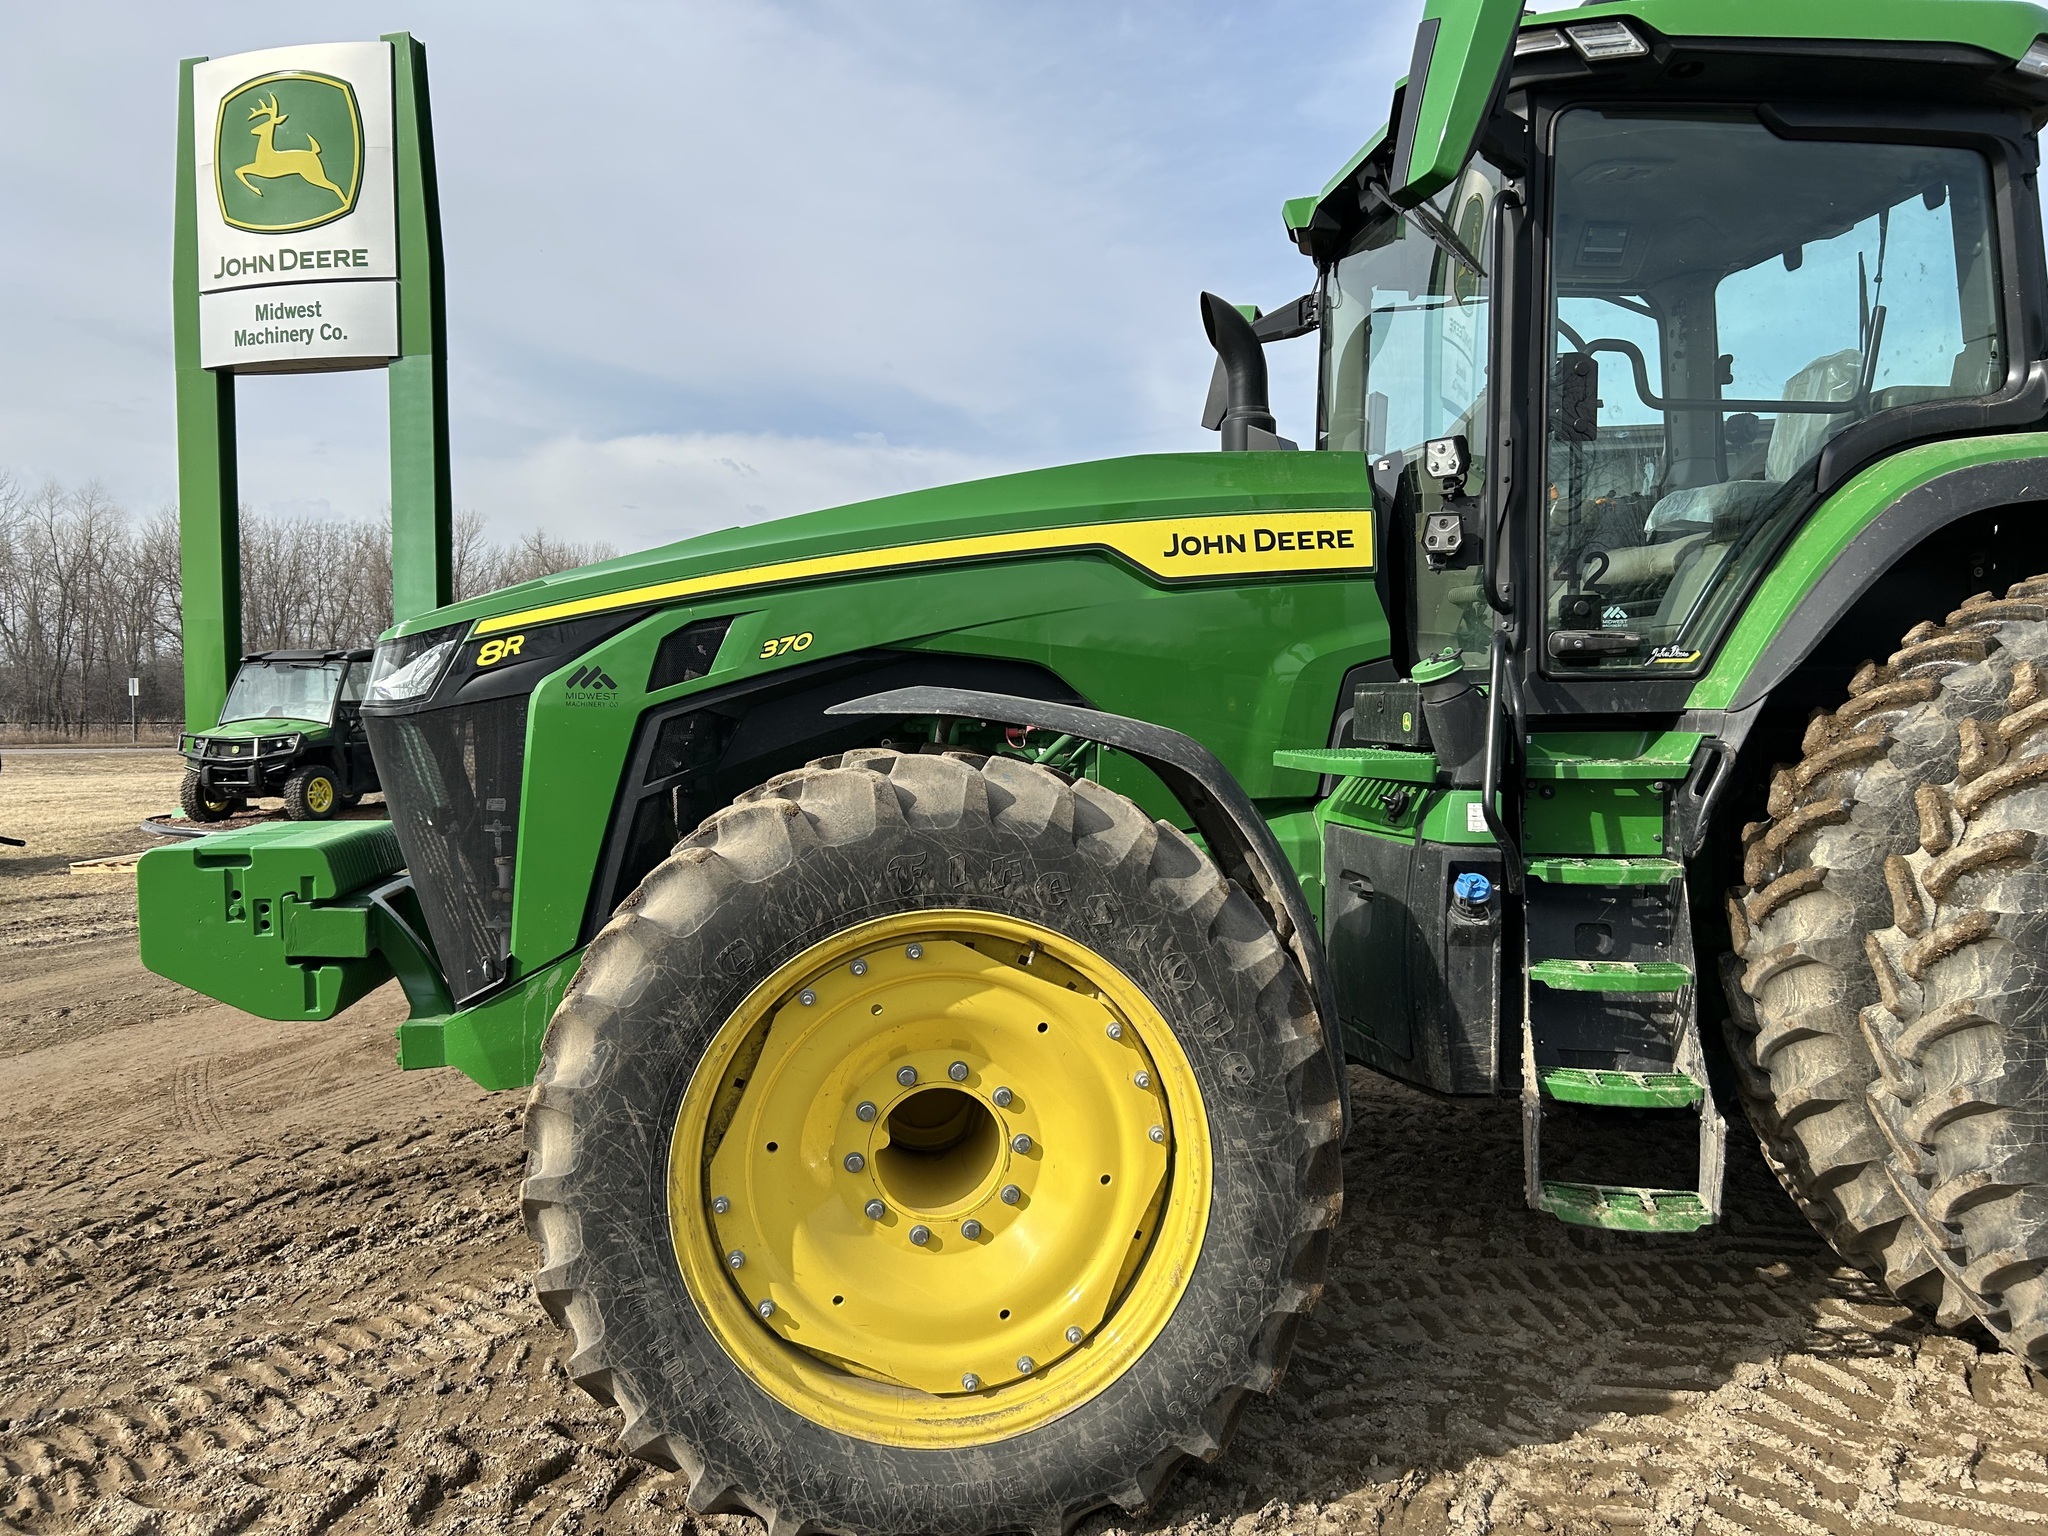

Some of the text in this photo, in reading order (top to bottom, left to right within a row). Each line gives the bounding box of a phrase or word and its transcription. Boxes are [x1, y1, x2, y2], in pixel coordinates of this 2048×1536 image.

[214, 248, 369, 279] JOHN DEERE
[255, 300, 322, 322] Midwest
[234, 323, 348, 348] Machinery Co.
[1163, 528, 1355, 557] JOHN DEERE
[476, 635, 525, 666] 8R
[758, 632, 814, 660] 370
[565, 692, 619, 700] MIDWEST
